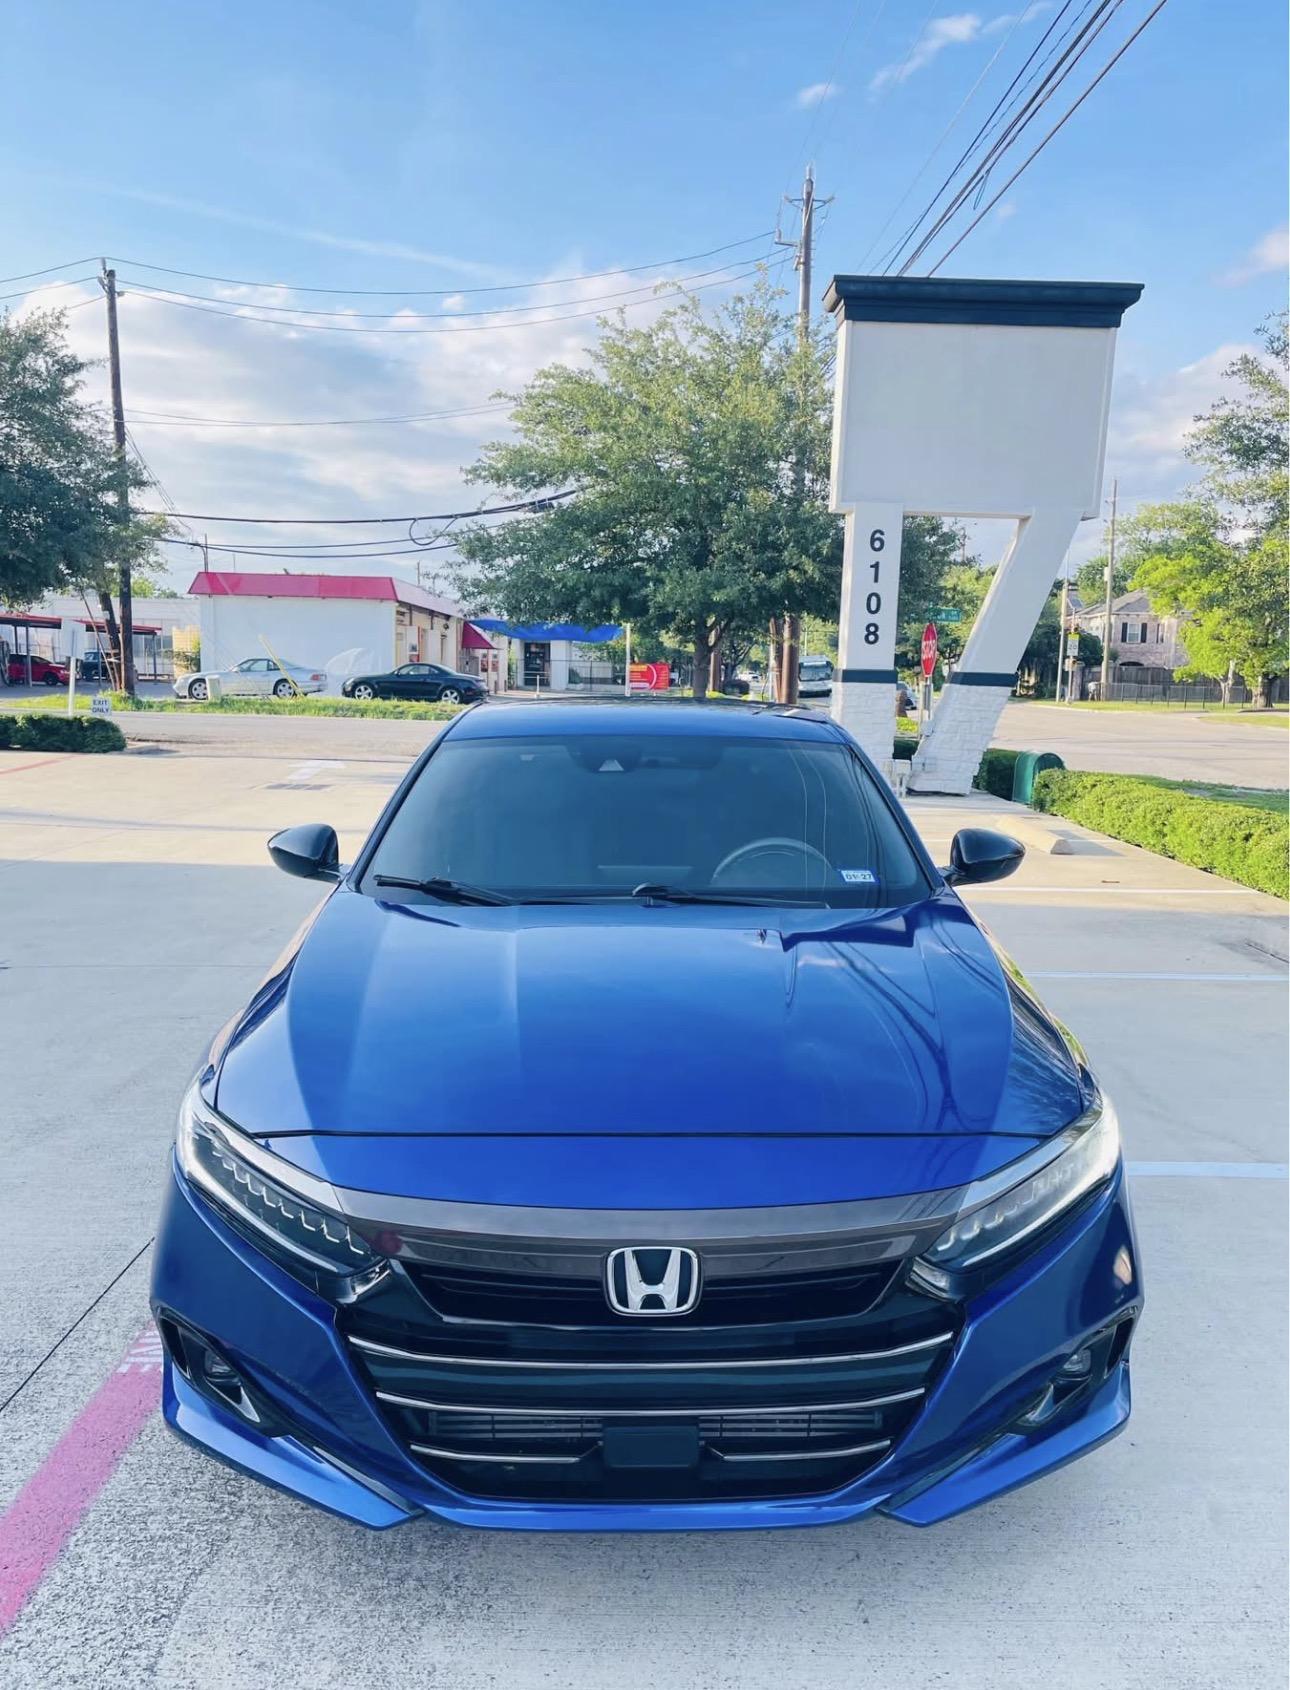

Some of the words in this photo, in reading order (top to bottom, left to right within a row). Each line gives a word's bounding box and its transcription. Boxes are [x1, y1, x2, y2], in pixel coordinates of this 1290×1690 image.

[864, 528, 886, 645] 6108
[921, 638, 937, 660] STOP
[92, 706, 109, 714] ONLY
